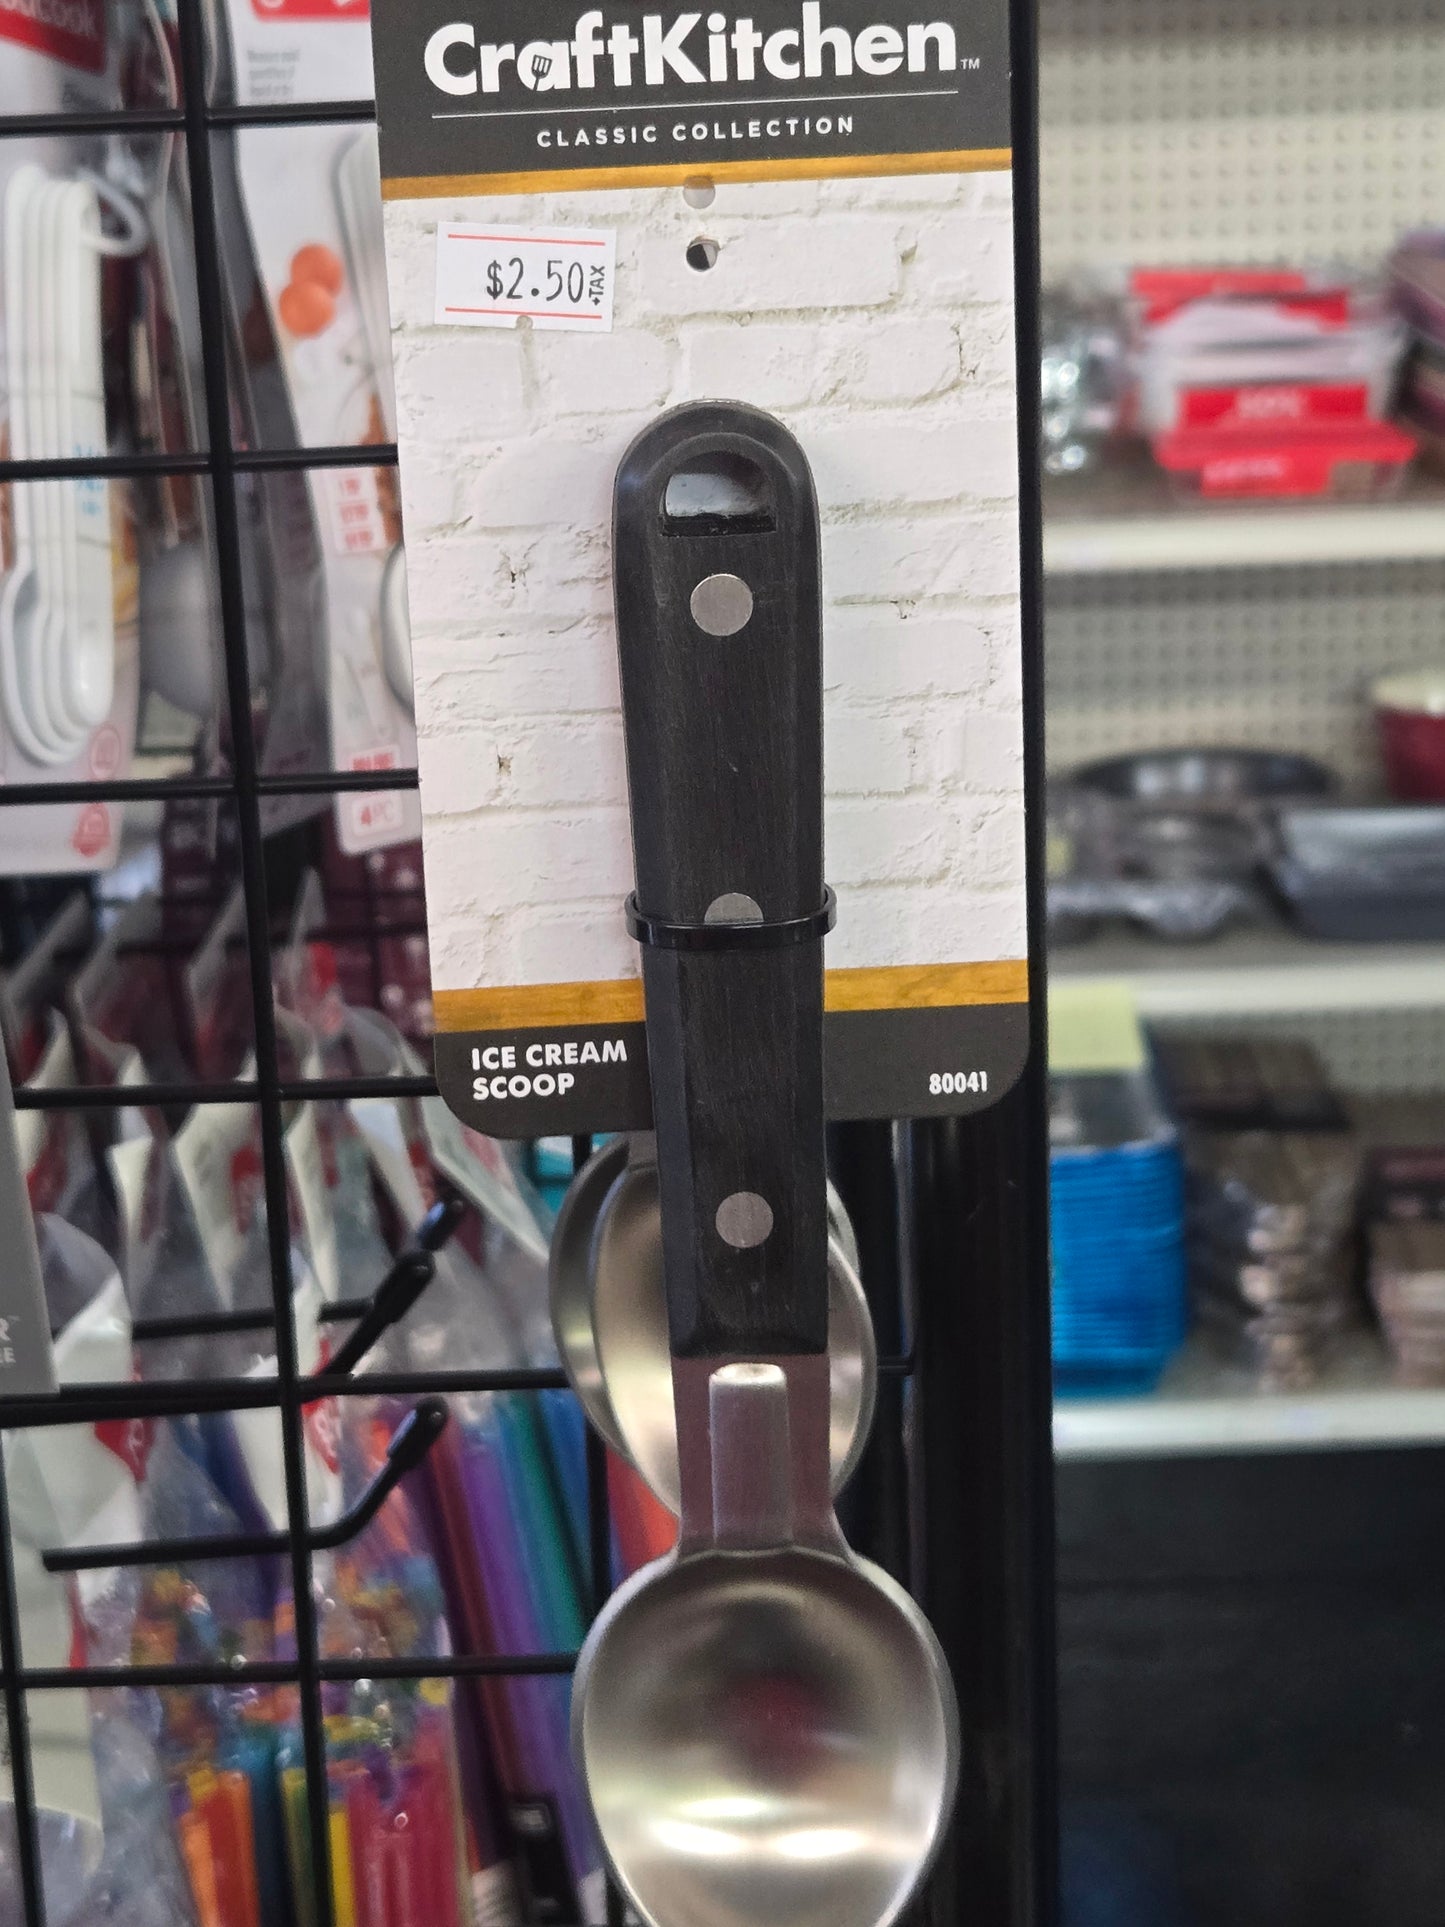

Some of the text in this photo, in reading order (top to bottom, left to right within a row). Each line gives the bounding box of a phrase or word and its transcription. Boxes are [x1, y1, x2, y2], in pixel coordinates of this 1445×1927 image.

[423, 1, 957, 96] CraftKitchen
[536, 115, 854, 148] CLASSIC COLLECTION
[486, 257, 584, 303] $2.50
[471, 1039, 628, 1071] ICE CREAM
[472, 1072, 575, 1101] SCOOP
[928, 1070, 989, 1095] 80041
